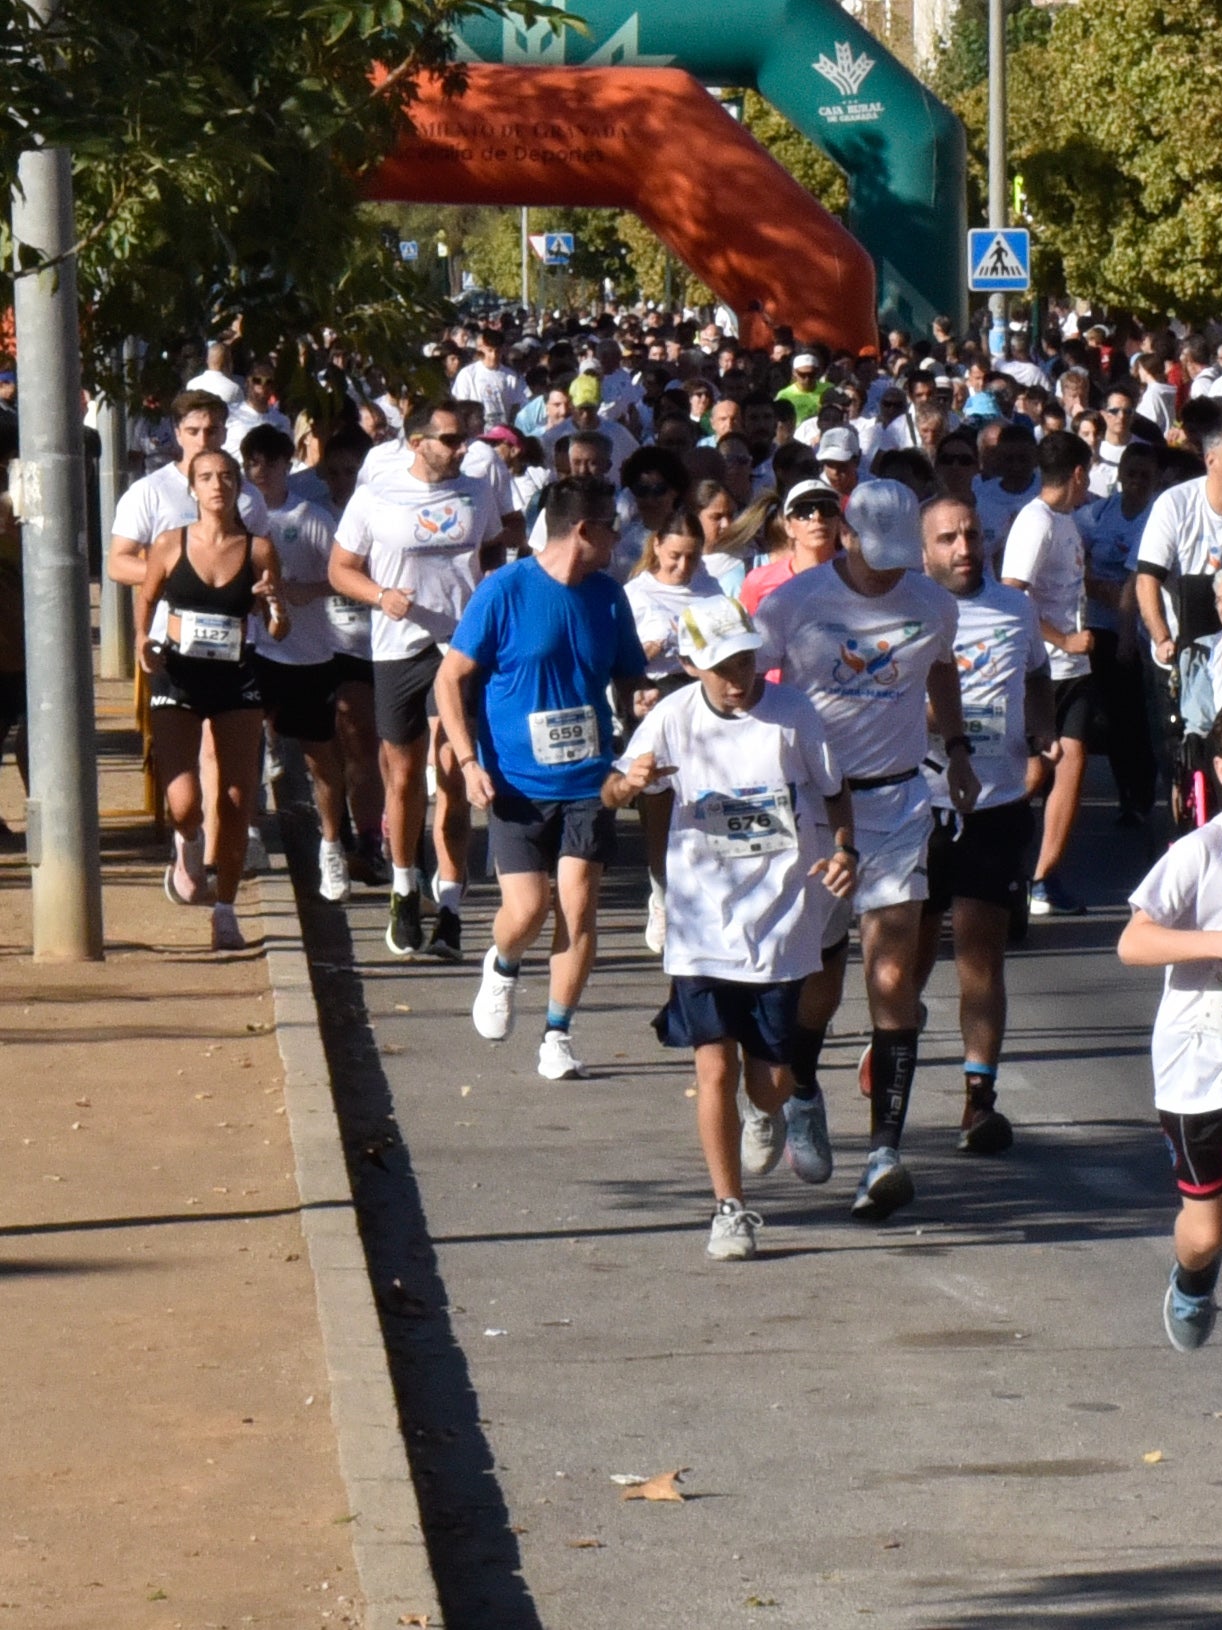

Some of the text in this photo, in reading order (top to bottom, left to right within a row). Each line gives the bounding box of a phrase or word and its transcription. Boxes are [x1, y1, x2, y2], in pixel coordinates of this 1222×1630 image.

[847, 102, 885, 114] RURAL
[480, 146, 508, 161] de
[194, 628, 230, 641] 1127
[549, 725, 583, 741] 659
[728, 813, 772, 831] 676
